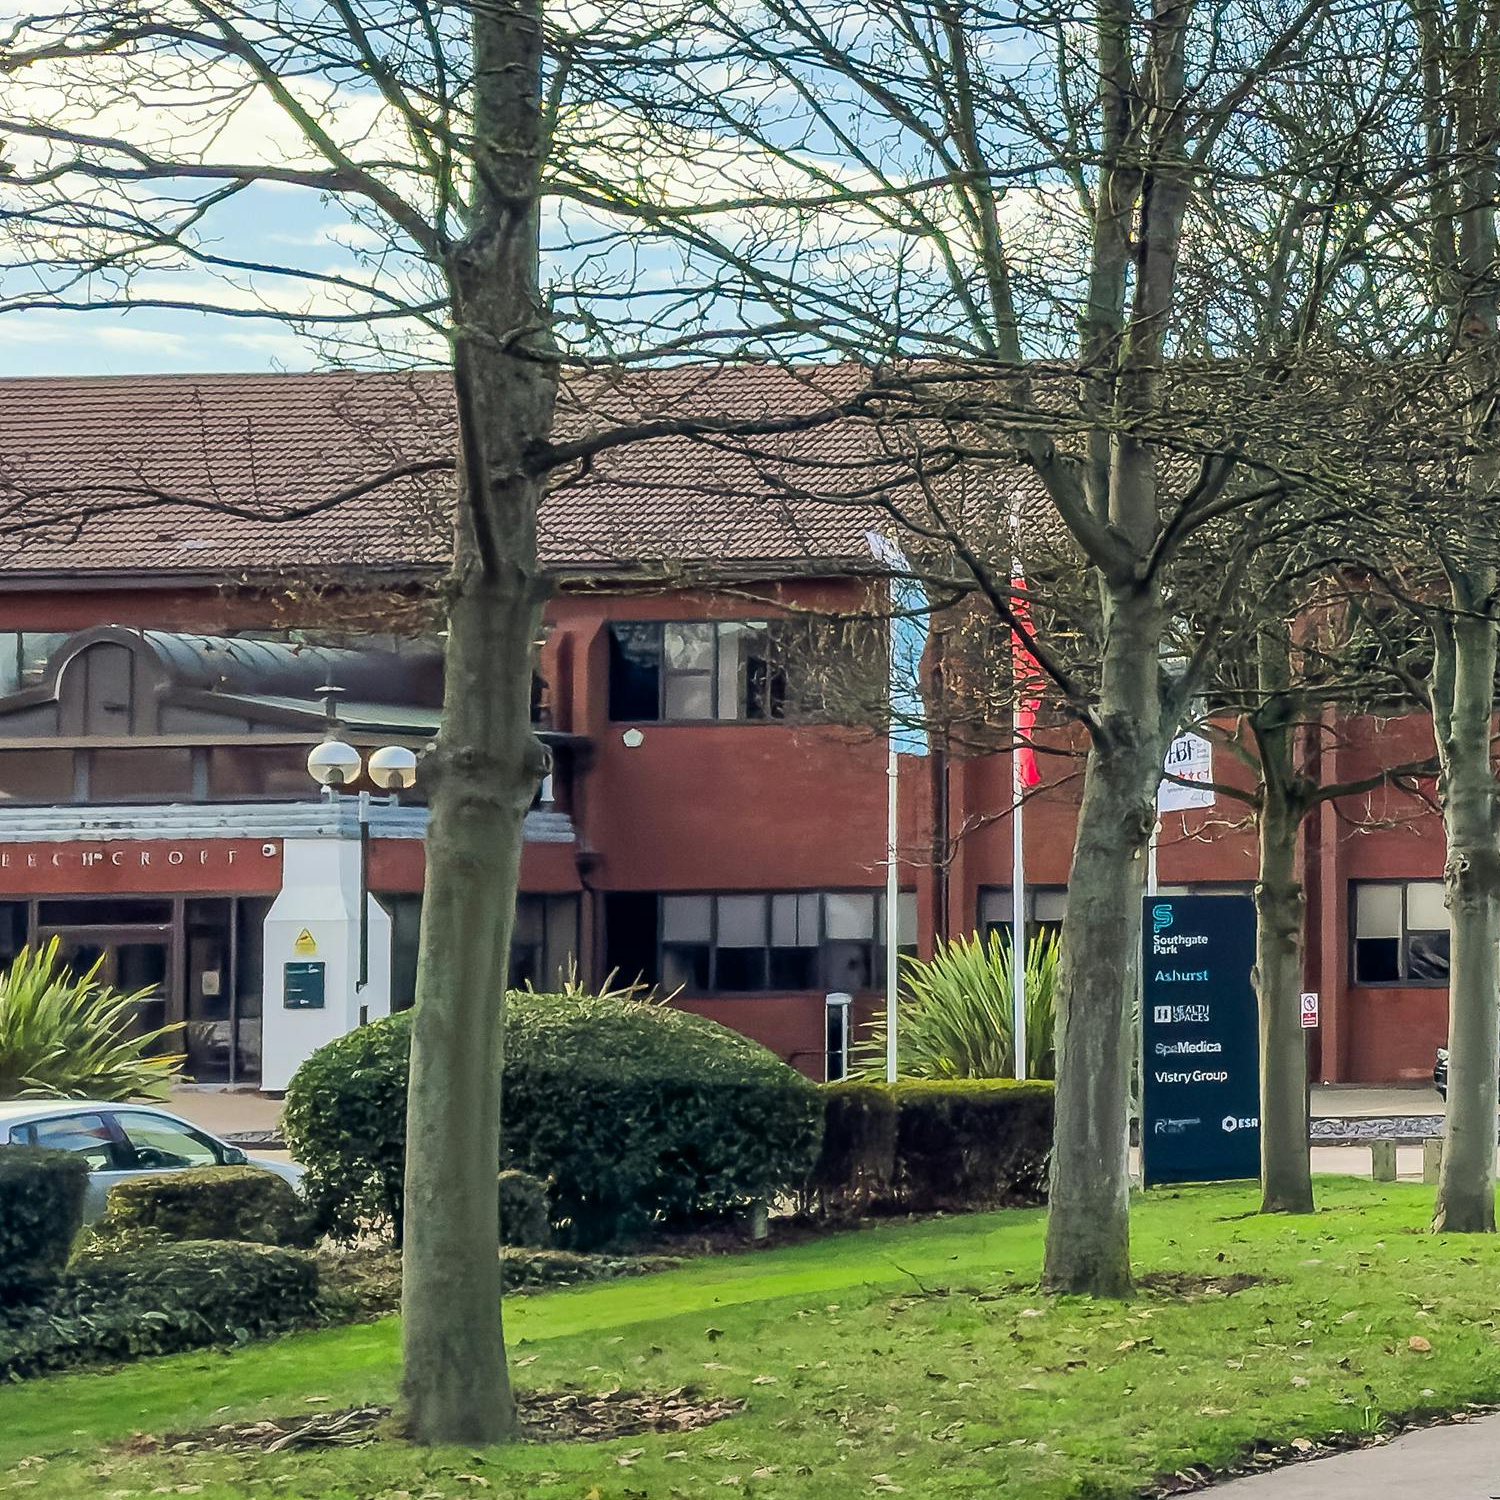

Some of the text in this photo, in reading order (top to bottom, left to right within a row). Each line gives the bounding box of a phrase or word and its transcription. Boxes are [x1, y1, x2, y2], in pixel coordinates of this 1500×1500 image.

[0, 850, 237, 867] EECHCROFT
[1153, 934, 1209, 947] Southgate
[1153, 944, 1178, 955] Park
[1155, 969, 1209, 981] Ashurst
[1173, 1012, 1210, 1023] SPACES
[1155, 1040, 1222, 1056] SpaMedica
[1155, 1070, 1228, 1084] Vistry Group
[1238, 1117, 1259, 1128] ESR
